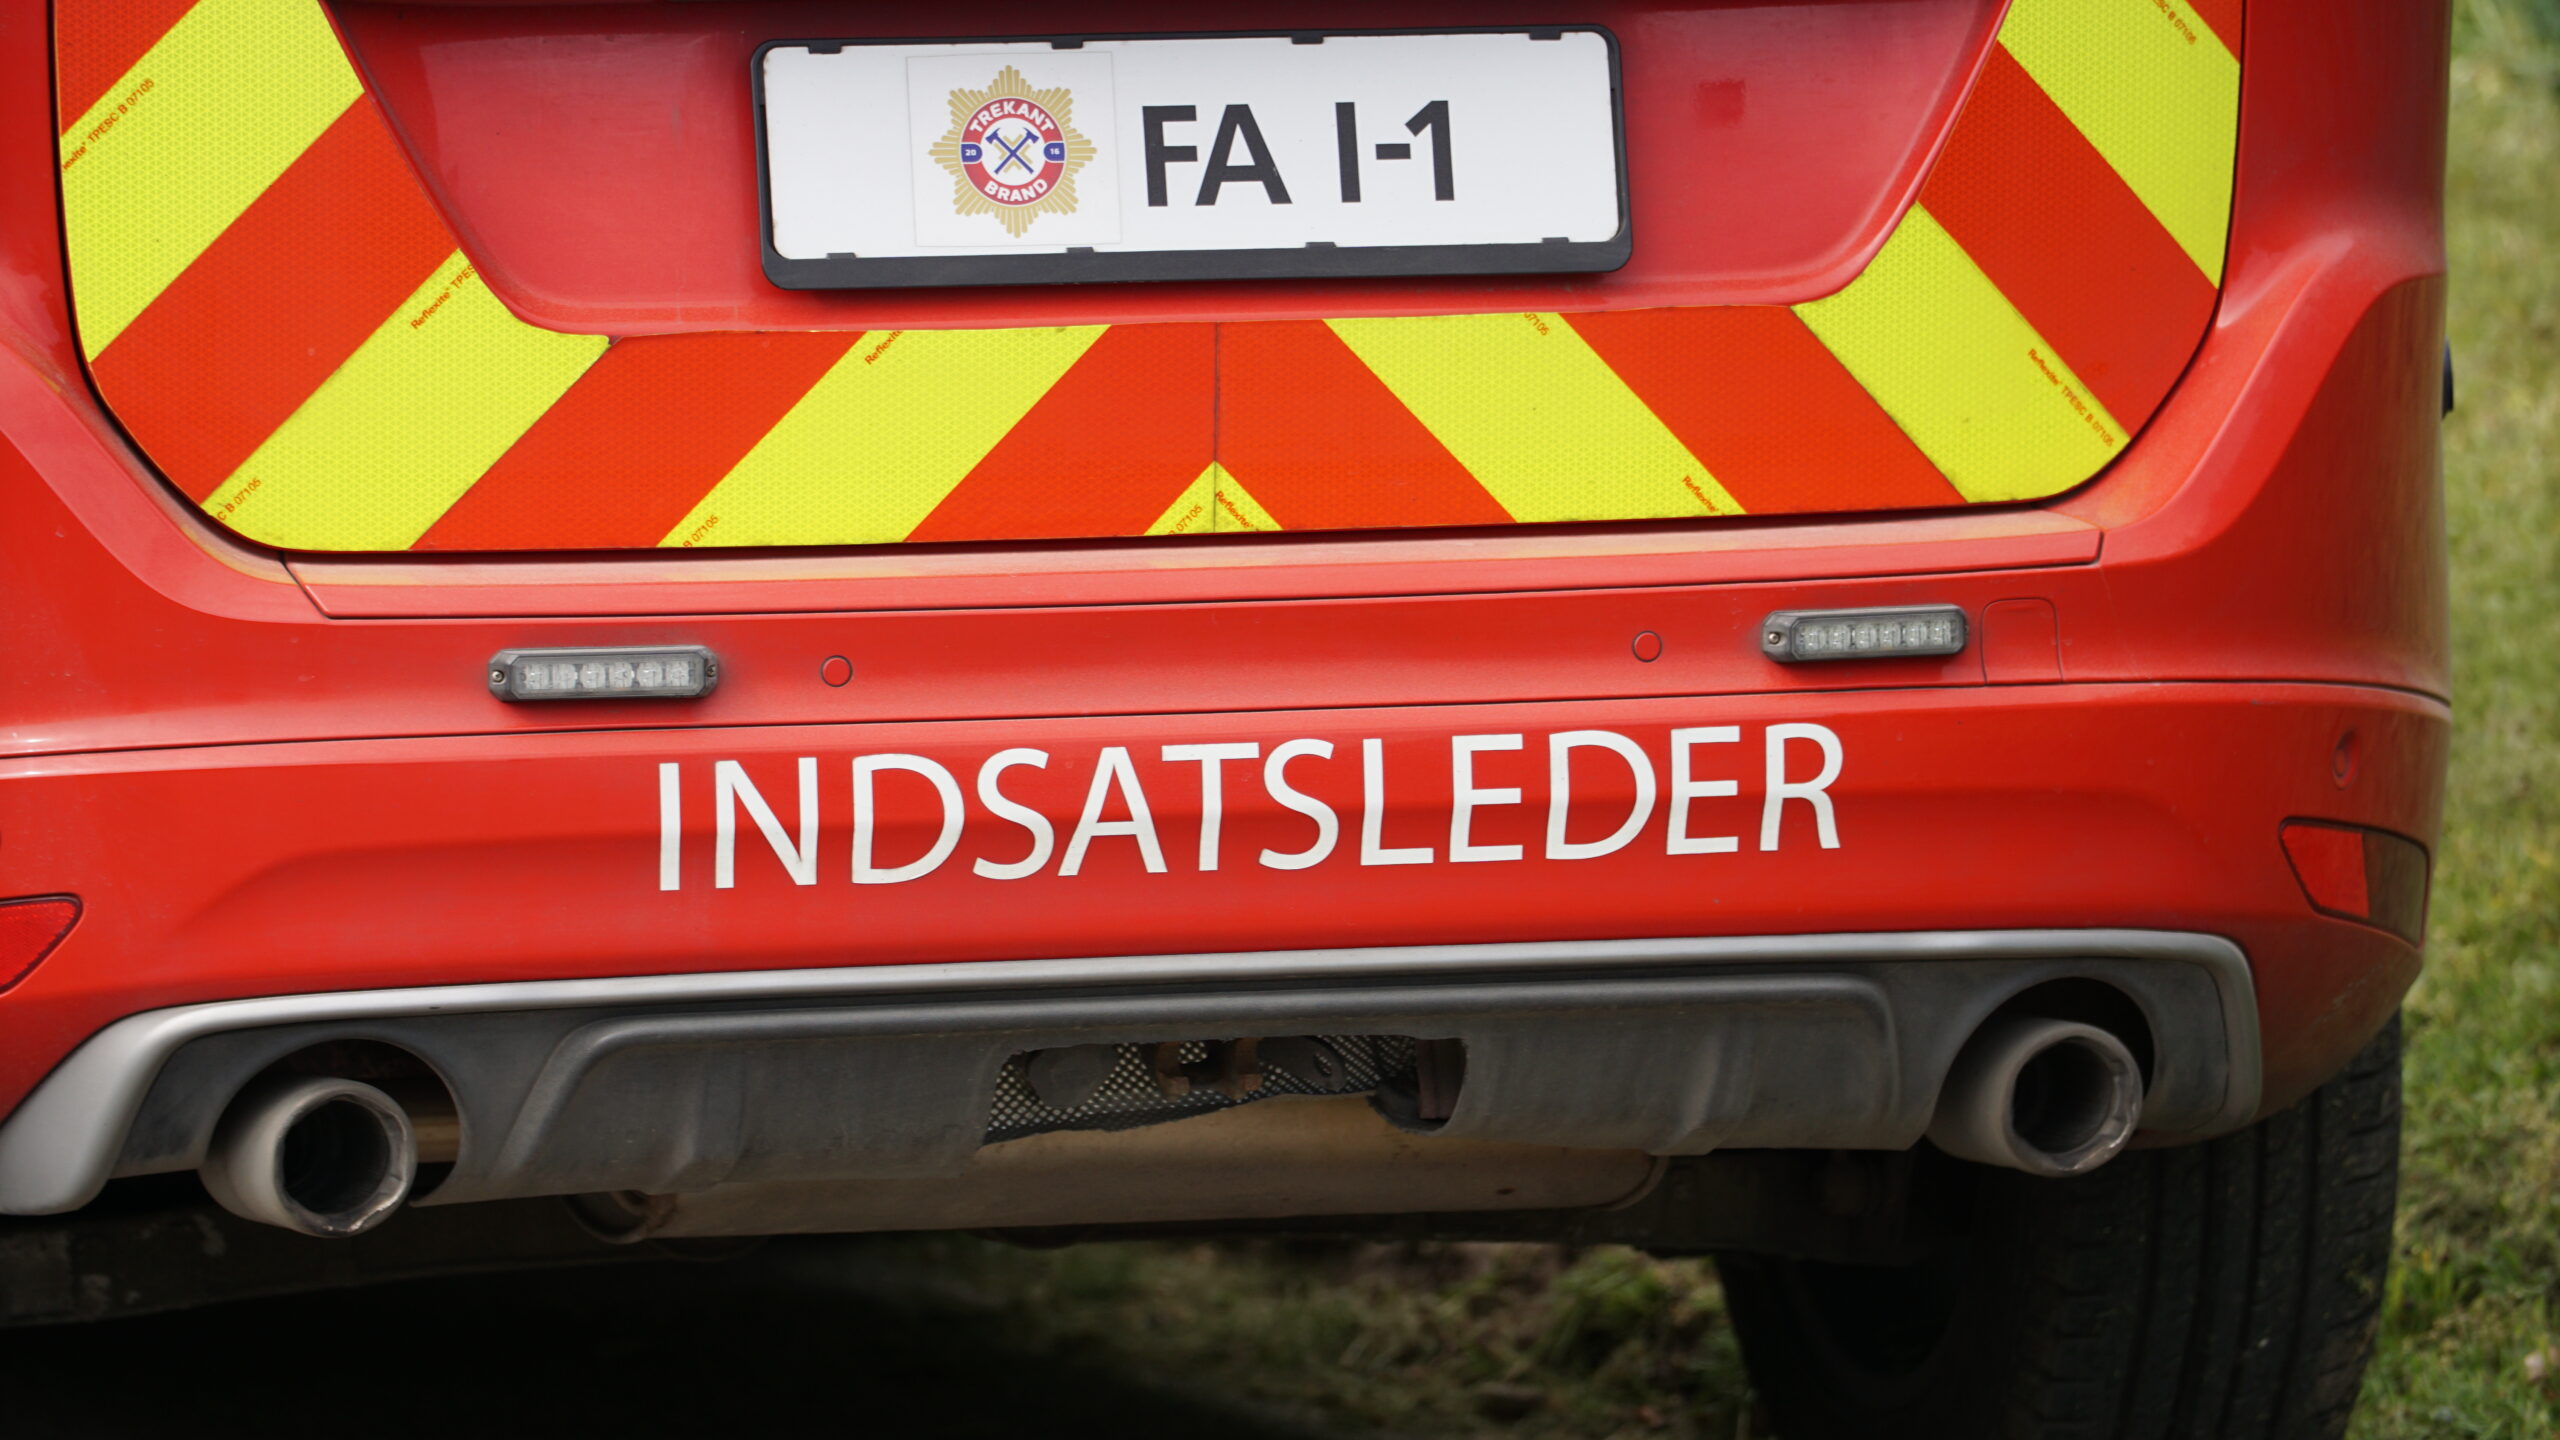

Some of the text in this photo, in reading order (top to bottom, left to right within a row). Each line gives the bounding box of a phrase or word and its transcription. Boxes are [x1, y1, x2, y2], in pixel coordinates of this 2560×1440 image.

[117, 104, 128, 114] B
[126, 78, 155, 106] 07105
[969, 101, 1055, 134] TREKANT
[1142, 100, 1455, 207] FA I-1
[984, 178, 1048, 202] BRAND
[224, 503, 236, 513] B
[1175, 503, 1203, 532] 07105
[691, 514, 719, 542] 07105
[659, 723, 1843, 891] INDSATSLEDER
